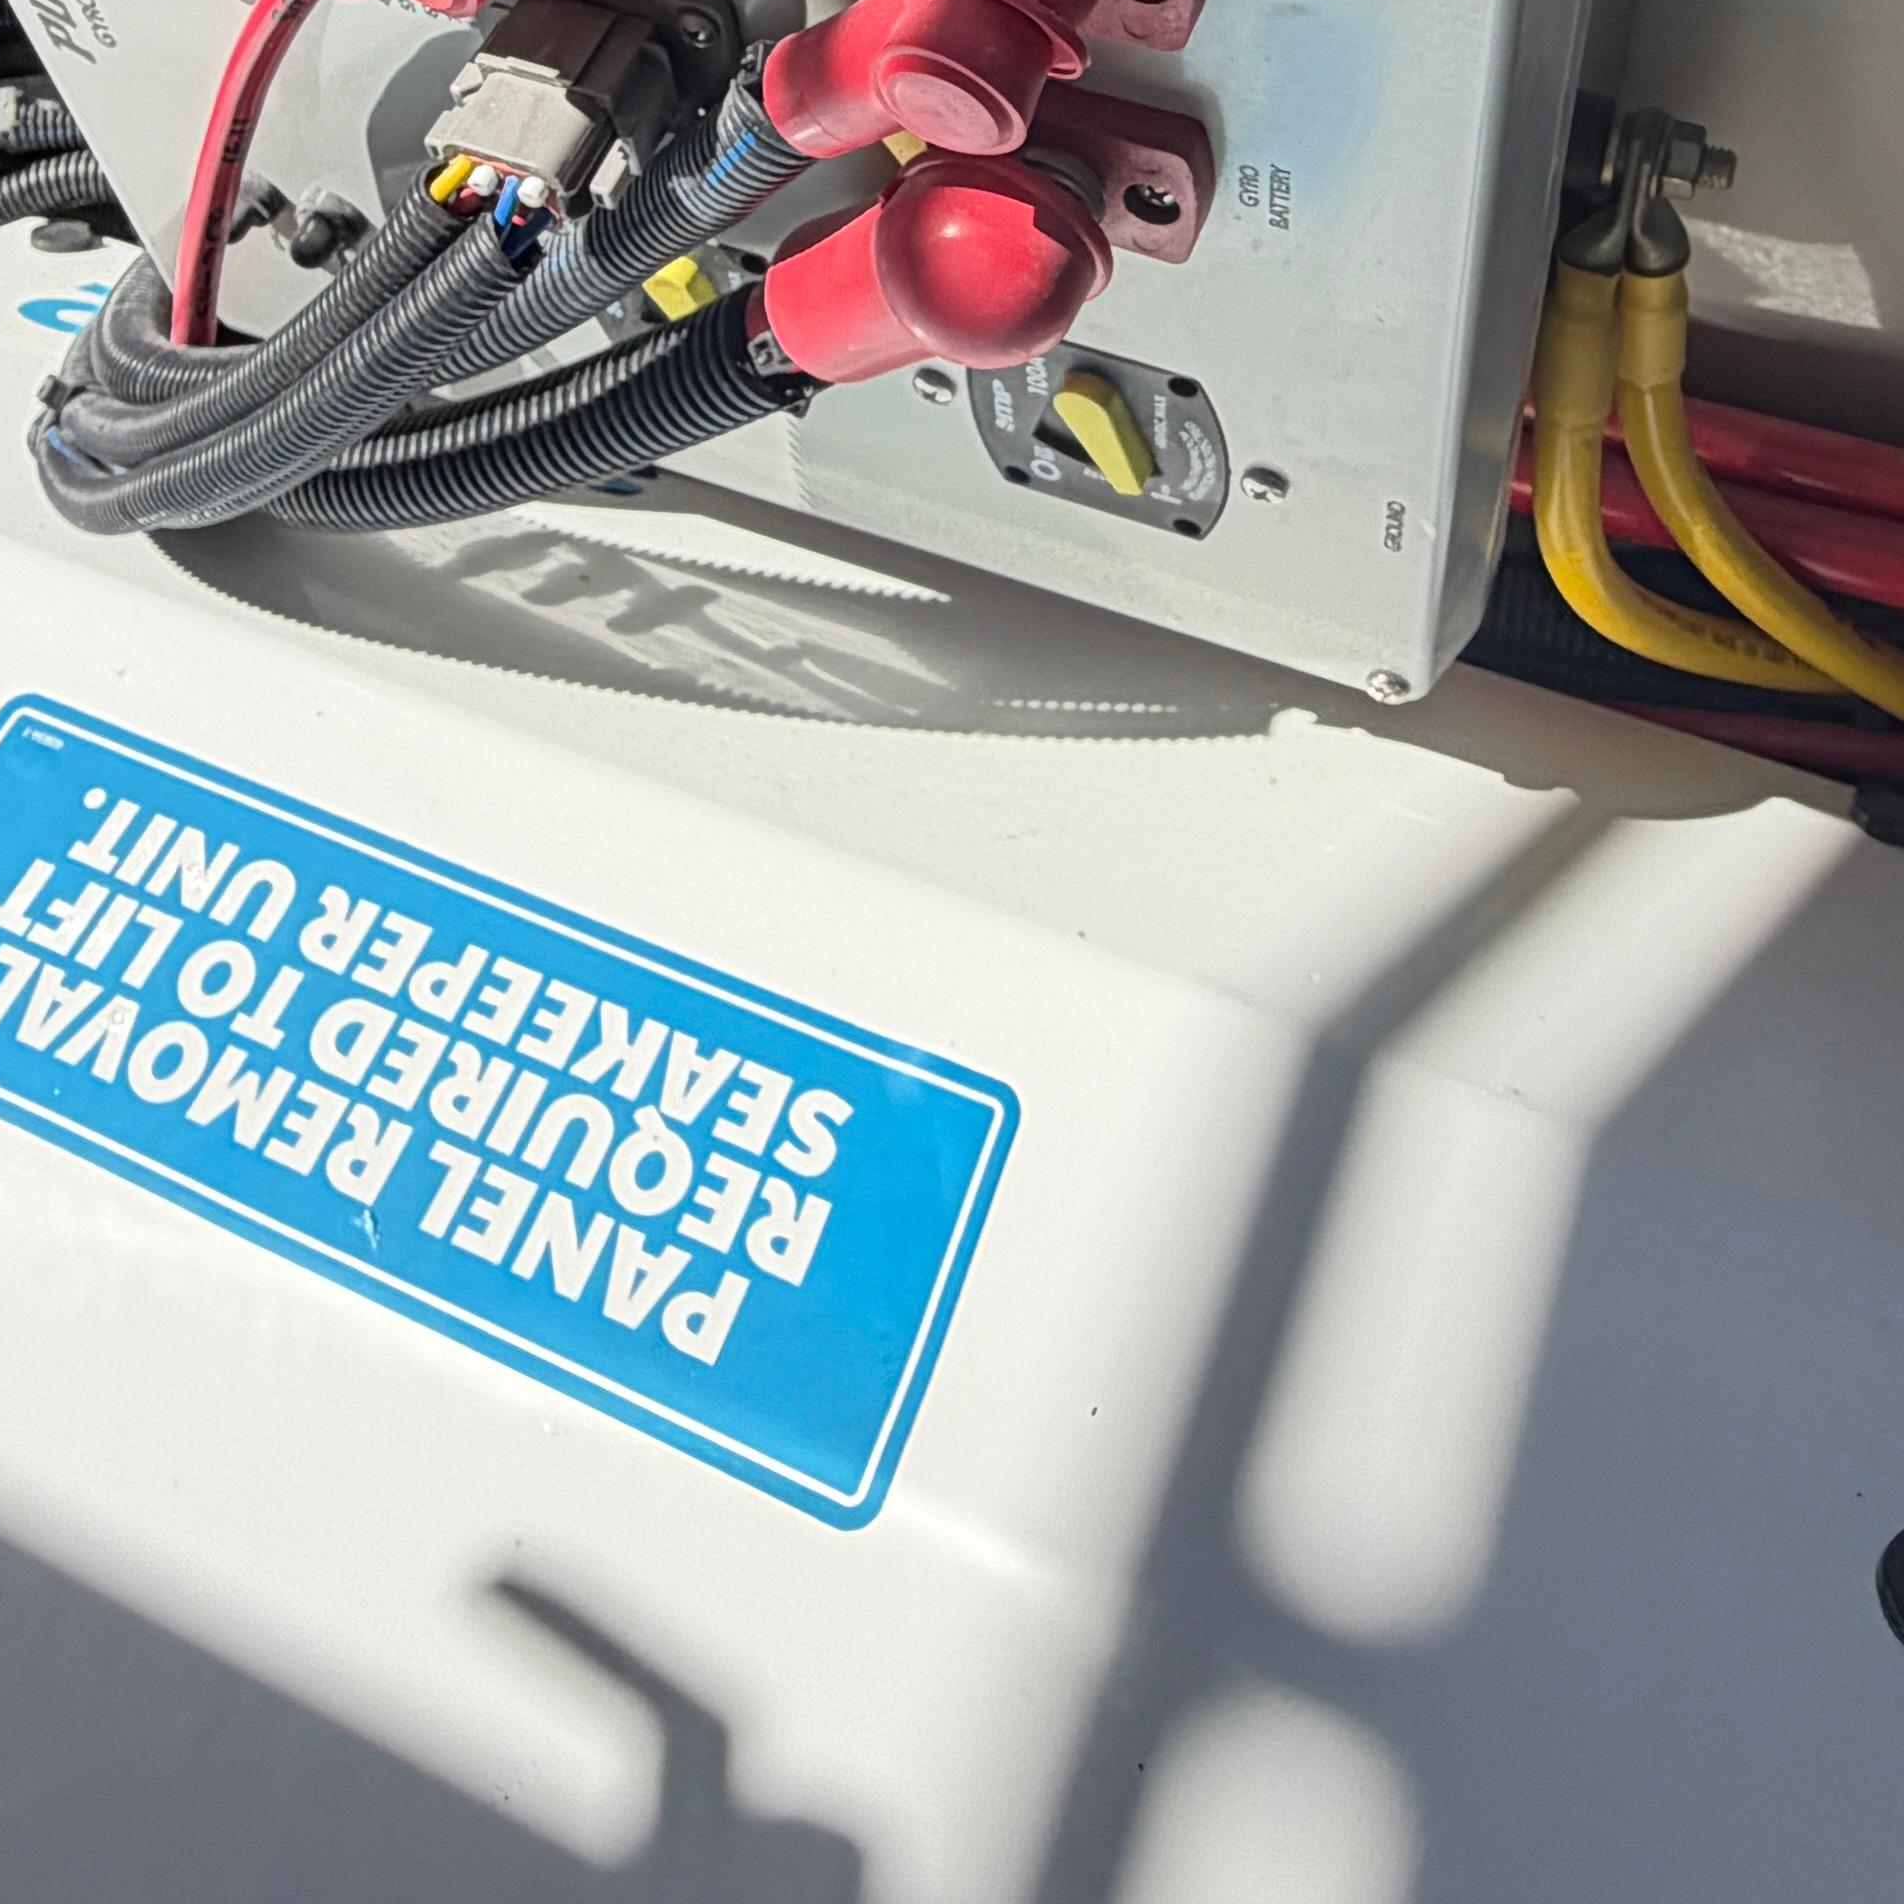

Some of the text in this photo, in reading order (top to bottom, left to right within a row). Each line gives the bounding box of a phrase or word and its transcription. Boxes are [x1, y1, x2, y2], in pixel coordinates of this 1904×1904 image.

[1238, 164, 1261, 208] GYRO
[1268, 163, 1292, 231] BATTERY
[67, 787, 854, 1177] SEAKEEPER UNIT.
[177, 939, 305, 1050] TO
[309, 998, 832, 1287] REQUIRED
[419, 1139, 751, 1367] PANEL
